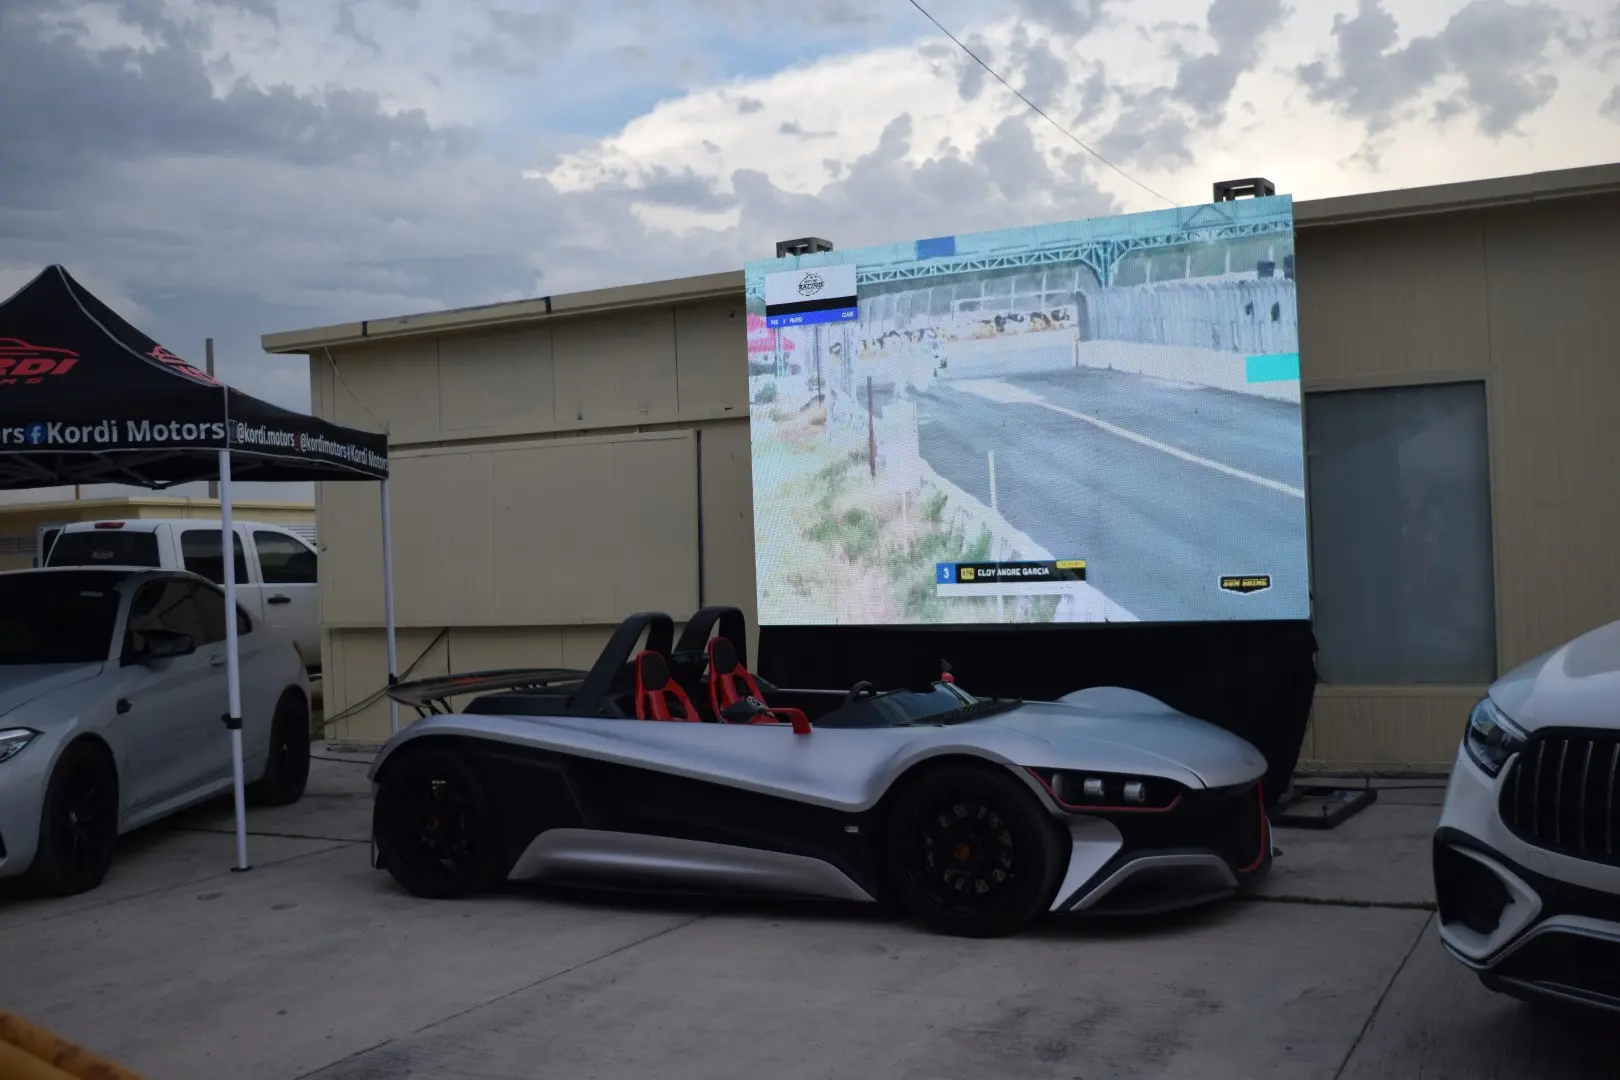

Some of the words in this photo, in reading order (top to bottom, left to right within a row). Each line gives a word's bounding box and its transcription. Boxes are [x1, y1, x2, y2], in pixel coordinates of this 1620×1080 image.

[0, 427, 25, 444] rs
[46, 420, 118, 444] Kordi
[127, 420, 225, 442] Motors
[236, 422, 295, 447] @kordi.motors
[300, 433, 347, 459] @kordimotors
[943, 567, 950, 579] 3
[977, 568, 996, 577] ELOY
[997, 567, 1021, 577] ANDRE
[1022, 567, 1049, 576] GARCIA
